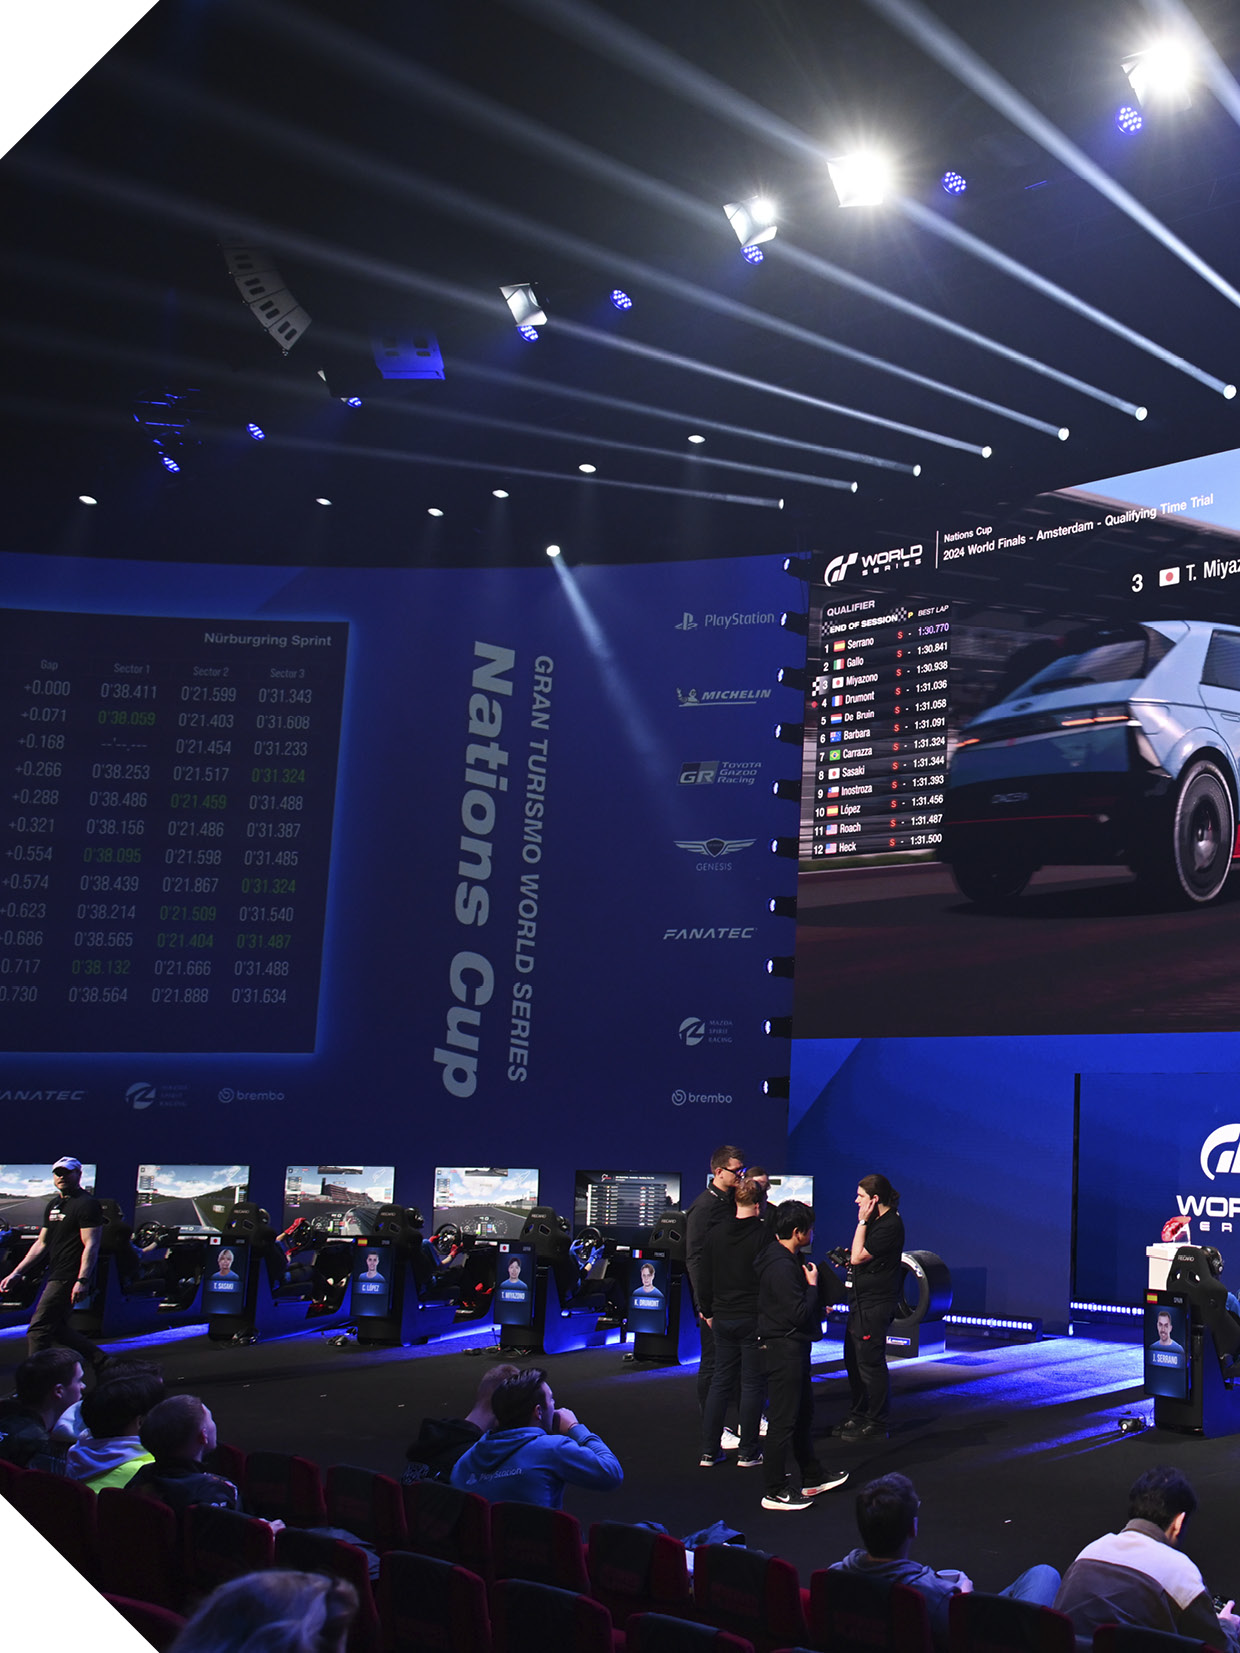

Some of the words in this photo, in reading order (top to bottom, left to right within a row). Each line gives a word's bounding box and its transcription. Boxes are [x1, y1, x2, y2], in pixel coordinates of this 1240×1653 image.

[943, 546, 965, 561] 2024
[967, 541, 995, 556] World
[998, 534, 1026, 549] Finals
[1036, 519, 1094, 541] Amsterdam
[1105, 506, 1157, 528] Qualifying
[1160, 500, 1186, 515] Time
[1190, 493, 1214, 509] Trial
[944, 529, 974, 543] Nations
[976, 525, 992, 538] Cup
[862, 544, 923, 568] WORLD
[862, 558, 921, 576] SERIES
[1131, 573, 1143, 593] 3
[1186, 564, 1197, 581] T.
[826, 600, 876, 617] QUALIFIER
[917, 607, 935, 617] BEST
[704, 611, 775, 628] PlayStation
[830, 624, 847, 634] END
[848, 621, 859, 631] OF
[861, 614, 898, 628] SESSION
[204, 631, 287, 647] Nürburgring
[291, 634, 332, 648] Sprint
[825, 644, 829, 653] 1
[847, 637, 874, 650] Serrano
[918, 622, 950, 636] 1:30.770
[823, 662, 829, 672] 2
[846, 656, 864, 668] Gallo
[917, 641, 948, 655] 1:30.841
[40, 659, 59, 671] Gap
[114, 663, 145, 675] Sector
[193, 666, 221, 677] Sector
[223, 667, 230, 677] 2
[270, 668, 297, 679] Sector
[298, 669, 305, 679] 3
[845, 673, 878, 686] Miyazono
[916, 660, 948, 674] 1:30.938
[100, 683, 157, 699] 0'38.411
[181, 686, 236, 702] 0'21.599
[258, 688, 313, 704] 0'31.343
[530, 655, 554, 731] GRAN
[701, 688, 772, 701] MICHELIN
[821, 698, 827, 708] 4
[845, 691, 875, 704] Drumont
[915, 680, 948, 693] 1:31.036
[179, 713, 234, 728] 0'21.403
[820, 716, 826, 725] 5
[856, 709, 875, 720] Bruin
[915, 699, 947, 712] 1:31.058
[820, 734, 826, 744] 6
[843, 729, 871, 740] Barbara
[914, 717, 946, 730] 1:31.091
[254, 741, 308, 757] 0'31.233
[819, 752, 825, 762] 7
[842, 747, 873, 759] Carrazza
[913, 736, 946, 749] 1:31.324
[92, 764, 150, 780] 0'38.253
[173, 766, 229, 782] 0'21.517
[719, 768, 758, 777] GAZOO
[721, 761, 761, 770] TOYOTA
[818, 771, 824, 780] 8
[842, 765, 865, 777] Sasaki
[913, 755, 945, 768] 1:31.344
[454, 640, 516, 926] Nations
[680, 768, 715, 785] GR
[717, 775, 755, 786] Racing
[817, 789, 823, 799] 9
[841, 785, 873, 796] Inostroza
[912, 775, 944, 787] 1:31.393
[89, 791, 148, 807] 0'38.486
[249, 795, 303, 811] 0'31.488
[522, 738, 548, 864] TURISMO
[815, 808, 825, 817] 10
[840, 804, 861, 815] López
[911, 794, 944, 806] 1:31.456
[168, 821, 224, 837] 0'21.486
[247, 822, 301, 838] 0'31.387
[814, 826, 824, 836] 11
[839, 822, 862, 834] Roach
[911, 814, 943, 826] 1:31.487
[814, 845, 824, 855] 12
[839, 841, 857, 853] Heck
[910, 833, 943, 846] 1:31.500
[165, 848, 222, 865] 0'21.598
[244, 850, 299, 866] 0'31.485
[696, 862, 732, 871] GENESIS
[80, 876, 139, 892] 0'38.439
[162, 877, 220, 893] 0'21.867
[77, 904, 137, 920] 0'38.214
[239, 907, 294, 922] 0'31.540
[515, 874, 543, 974] WORLD
[662, 928, 754, 939] FANATEC
[154, 961, 211, 976] 0'21.666
[234, 961, 289, 977] 0'31.488
[69, 987, 128, 1003] 0'38.564
[151, 988, 208, 1003] 0'21.888
[232, 988, 286, 1004] 0'31.634
[433, 951, 495, 1098] Cup
[507, 981, 533, 1082] SERIES
[236, 1088, 285, 1102] brembo
[689, 1092, 733, 1103] brembo
